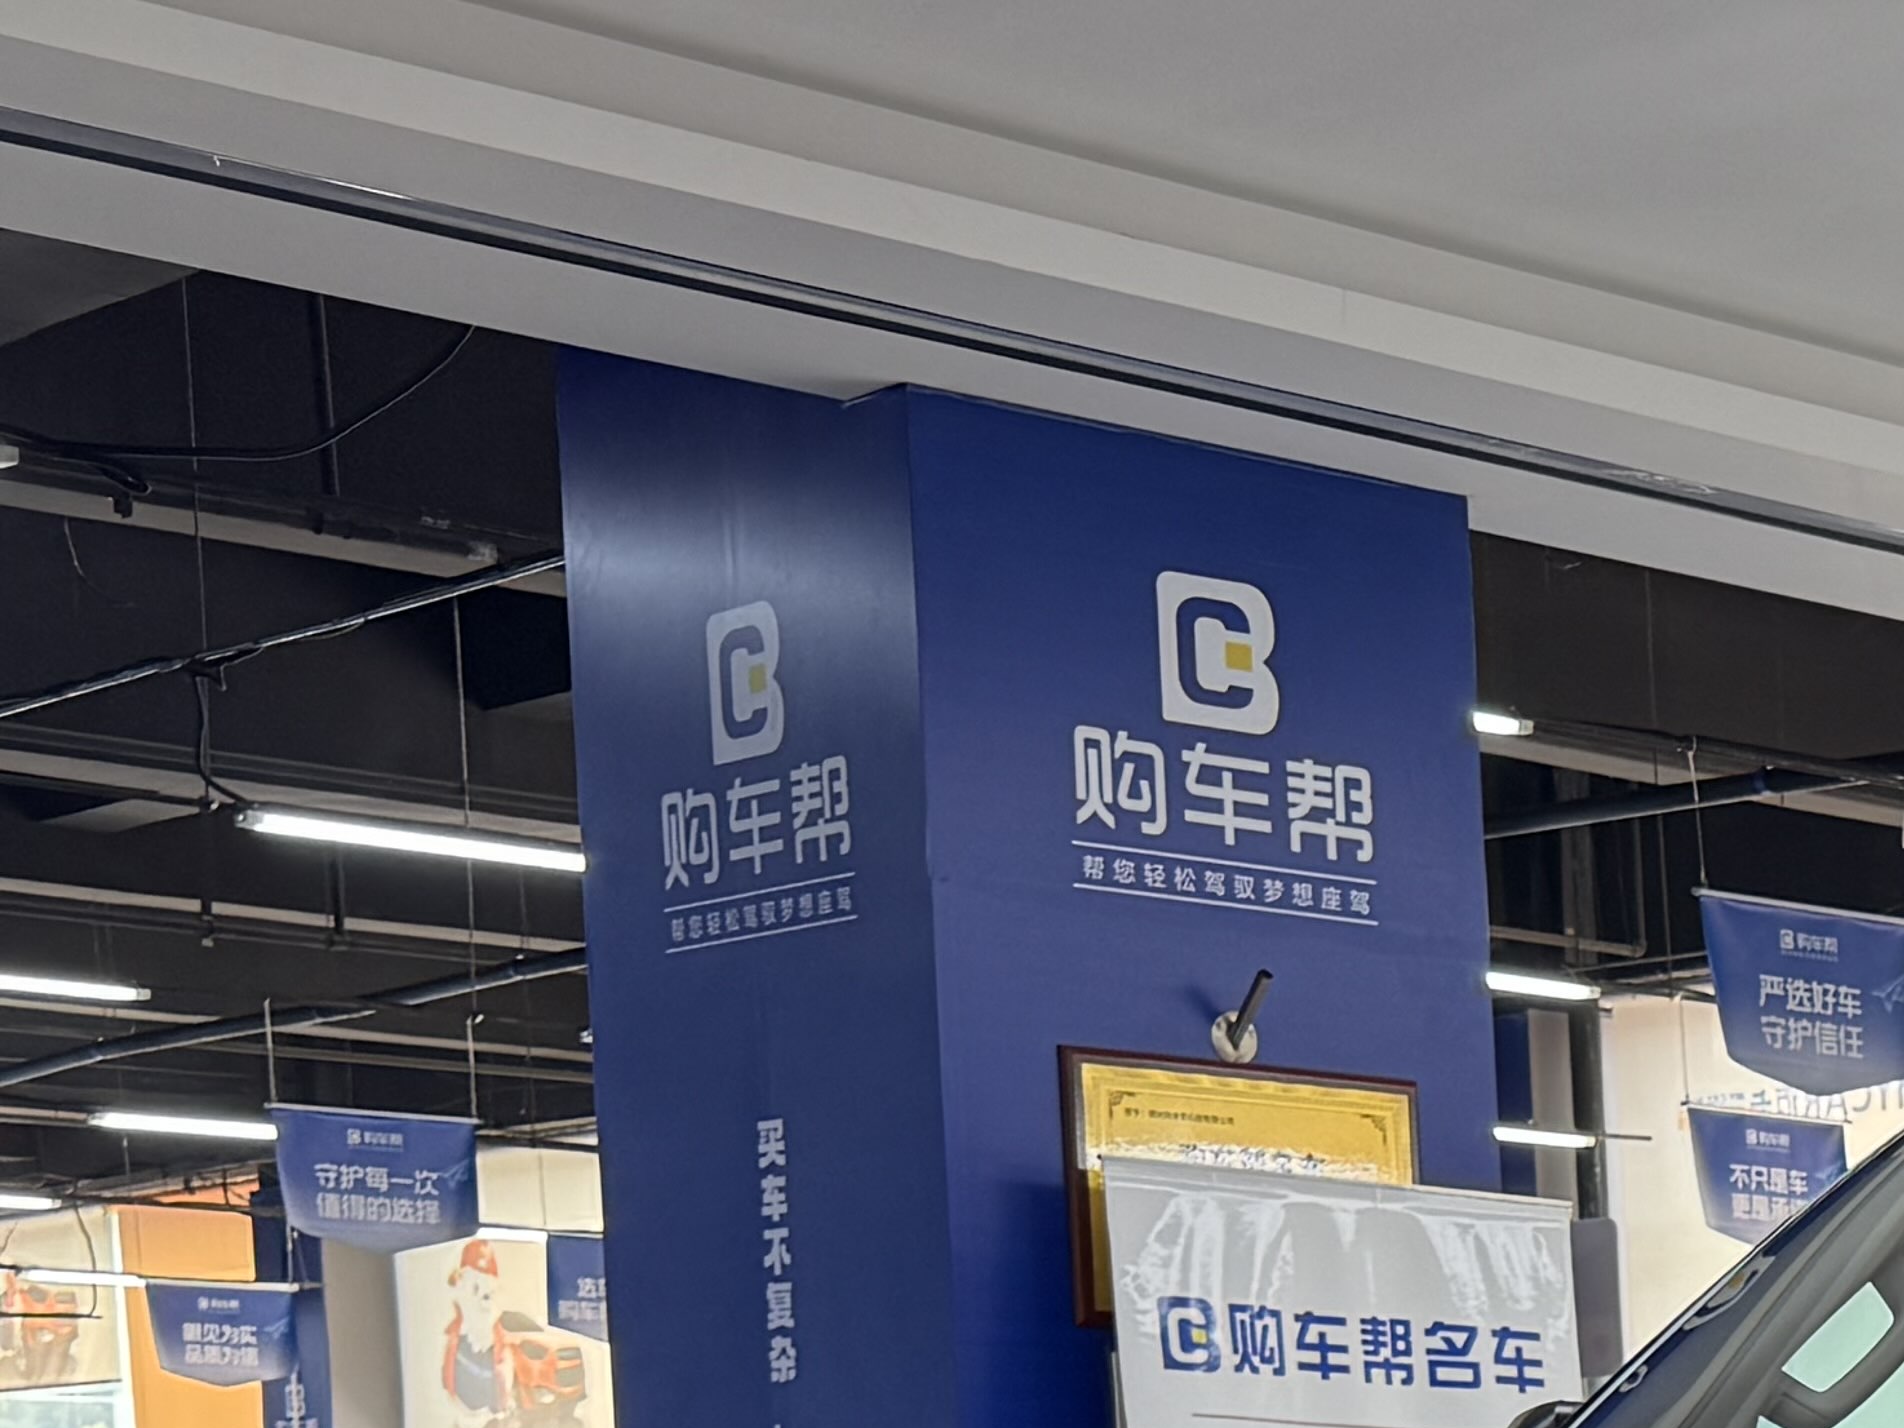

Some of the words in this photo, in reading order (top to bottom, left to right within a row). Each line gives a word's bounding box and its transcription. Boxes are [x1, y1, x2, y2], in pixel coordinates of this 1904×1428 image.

[1071, 724, 1376, 863] 购车帮
[660, 754, 852, 891] 购车帮
[1082, 854, 1372, 916] 帮您轻松驾驭梦想座驾
[671, 886, 852, 942] 帮您轻松驾驭梦想座驾
[1759, 974, 1863, 1018] 严选好车
[1760, 1015, 1864, 1058] 守护信任
[314, 1163, 440, 1196] 守护每一次
[1729, 1163, 1808, 1196] 不只是车
[1230, 1302, 1546, 1394] 购车帮名车
